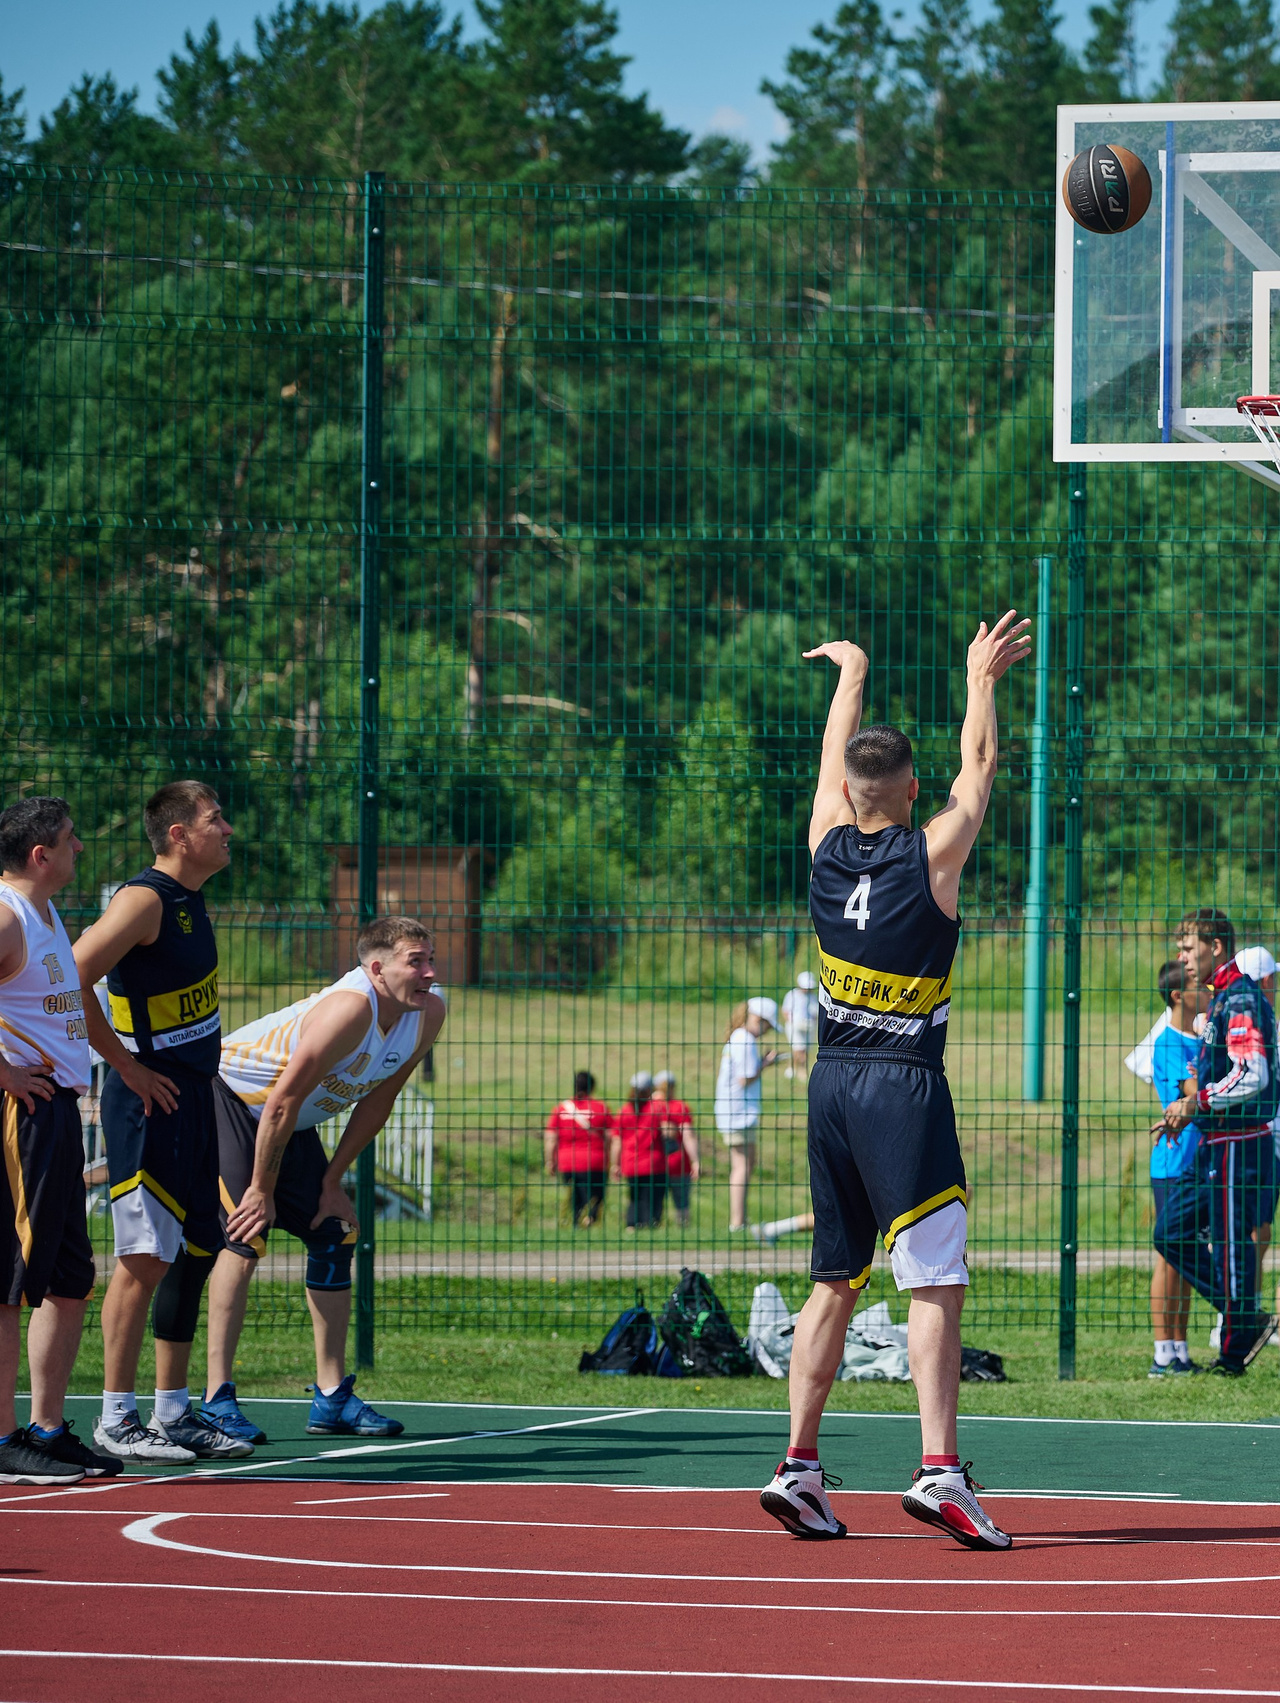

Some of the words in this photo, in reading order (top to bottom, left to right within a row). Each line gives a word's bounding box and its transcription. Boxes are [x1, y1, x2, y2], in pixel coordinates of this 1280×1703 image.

[843, 873, 872, 931] 4
[42, 953, 65, 985] 15
[168, 1025, 206, 1044] АЛТАЙСКАЯ
